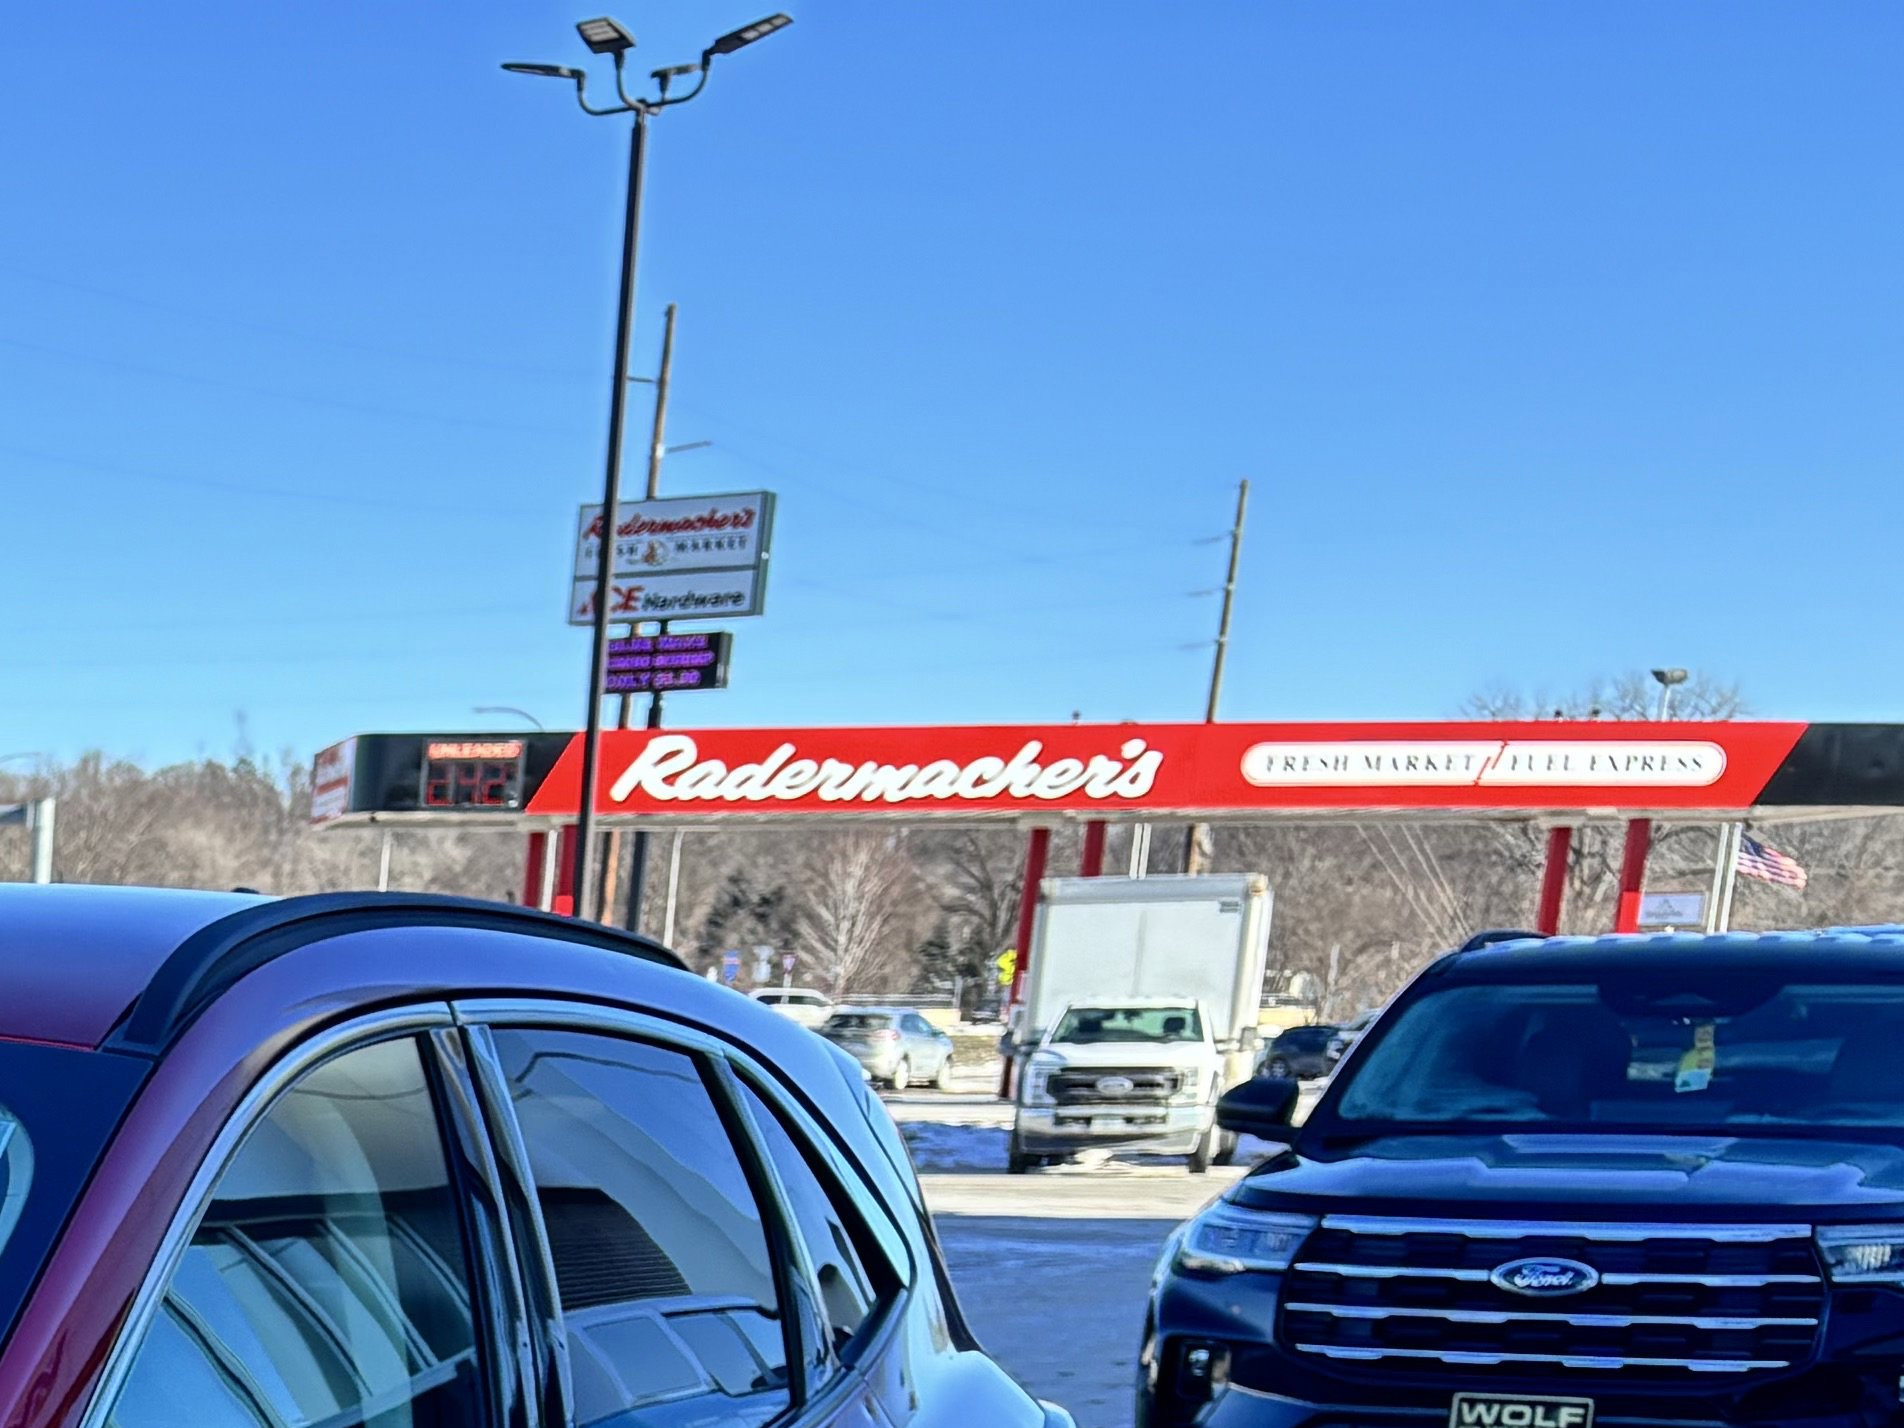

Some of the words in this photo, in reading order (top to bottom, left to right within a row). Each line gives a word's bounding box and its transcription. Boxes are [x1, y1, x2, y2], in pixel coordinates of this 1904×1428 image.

[642, 590, 744, 611] Hardware
[610, 734, 1164, 802] Radermacher's
[1266, 754, 1349, 772] FRESH
[1363, 754, 1475, 771] MARKET
[1510, 754, 1573, 771] FUEL
[1589, 754, 1703, 771] EXPRESS
[1461, 1402, 1585, 1428] WOLF
